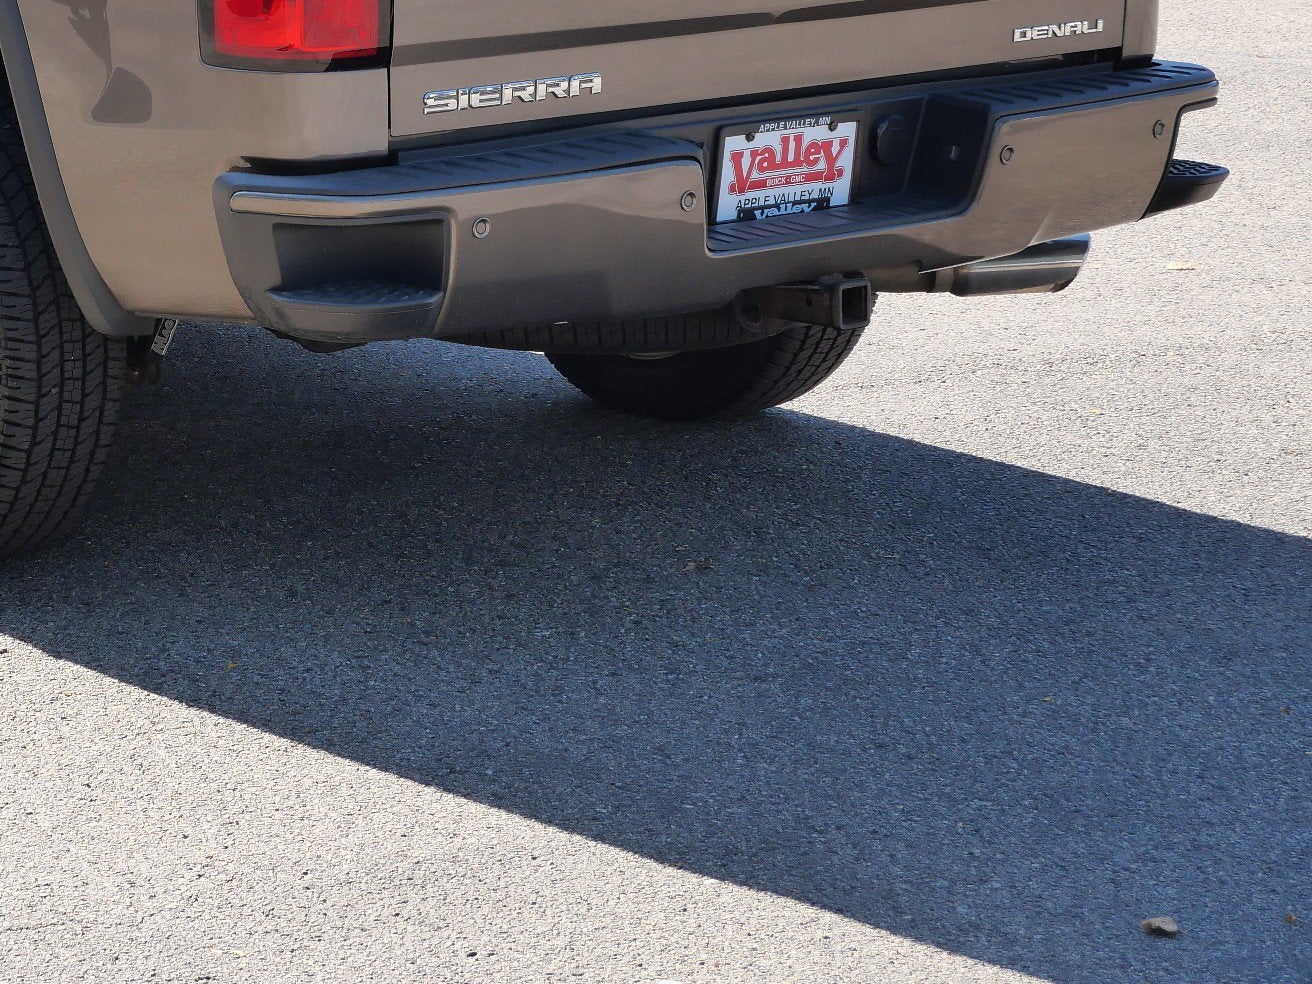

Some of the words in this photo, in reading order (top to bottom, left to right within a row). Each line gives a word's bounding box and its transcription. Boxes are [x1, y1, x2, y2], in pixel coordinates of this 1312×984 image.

[1013, 19, 1104, 42] DENALI
[423, 71, 602, 115] SIERRA
[759, 122, 785, 133] APPLE
[819, 116, 831, 125] MN
[730, 132, 849, 195] Valley
[767, 176, 786, 186] BUICK
[791, 174, 806, 183] GMC
[818, 186, 834, 197] MN
[754, 202, 817, 220] Valley
